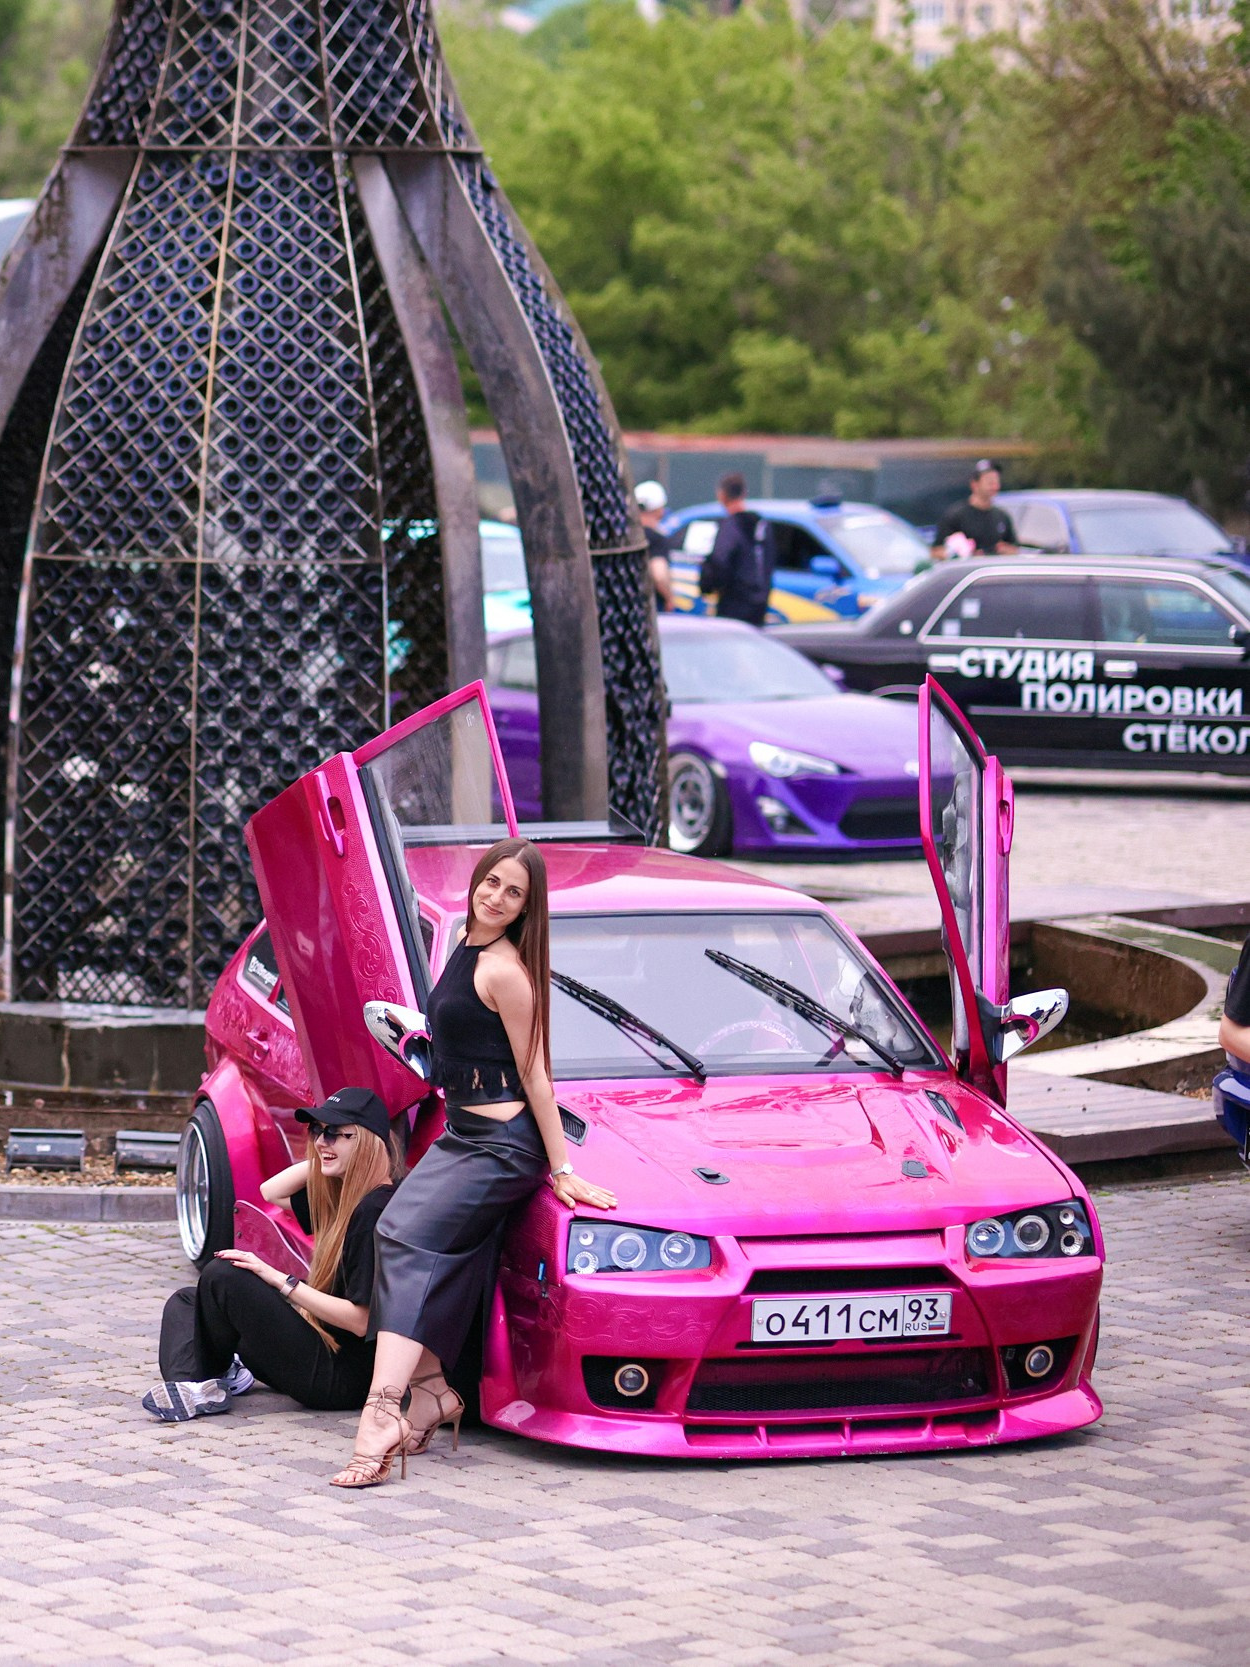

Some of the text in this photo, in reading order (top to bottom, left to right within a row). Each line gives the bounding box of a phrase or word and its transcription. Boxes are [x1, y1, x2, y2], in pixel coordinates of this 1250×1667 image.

[957, 649, 1094, 682] СТУДИЯ
[1021, 682, 1243, 717] ПОЛИРОВКИ
[908, 1298, 939, 1322] 93
[904, 1322, 928, 1332] RUS
